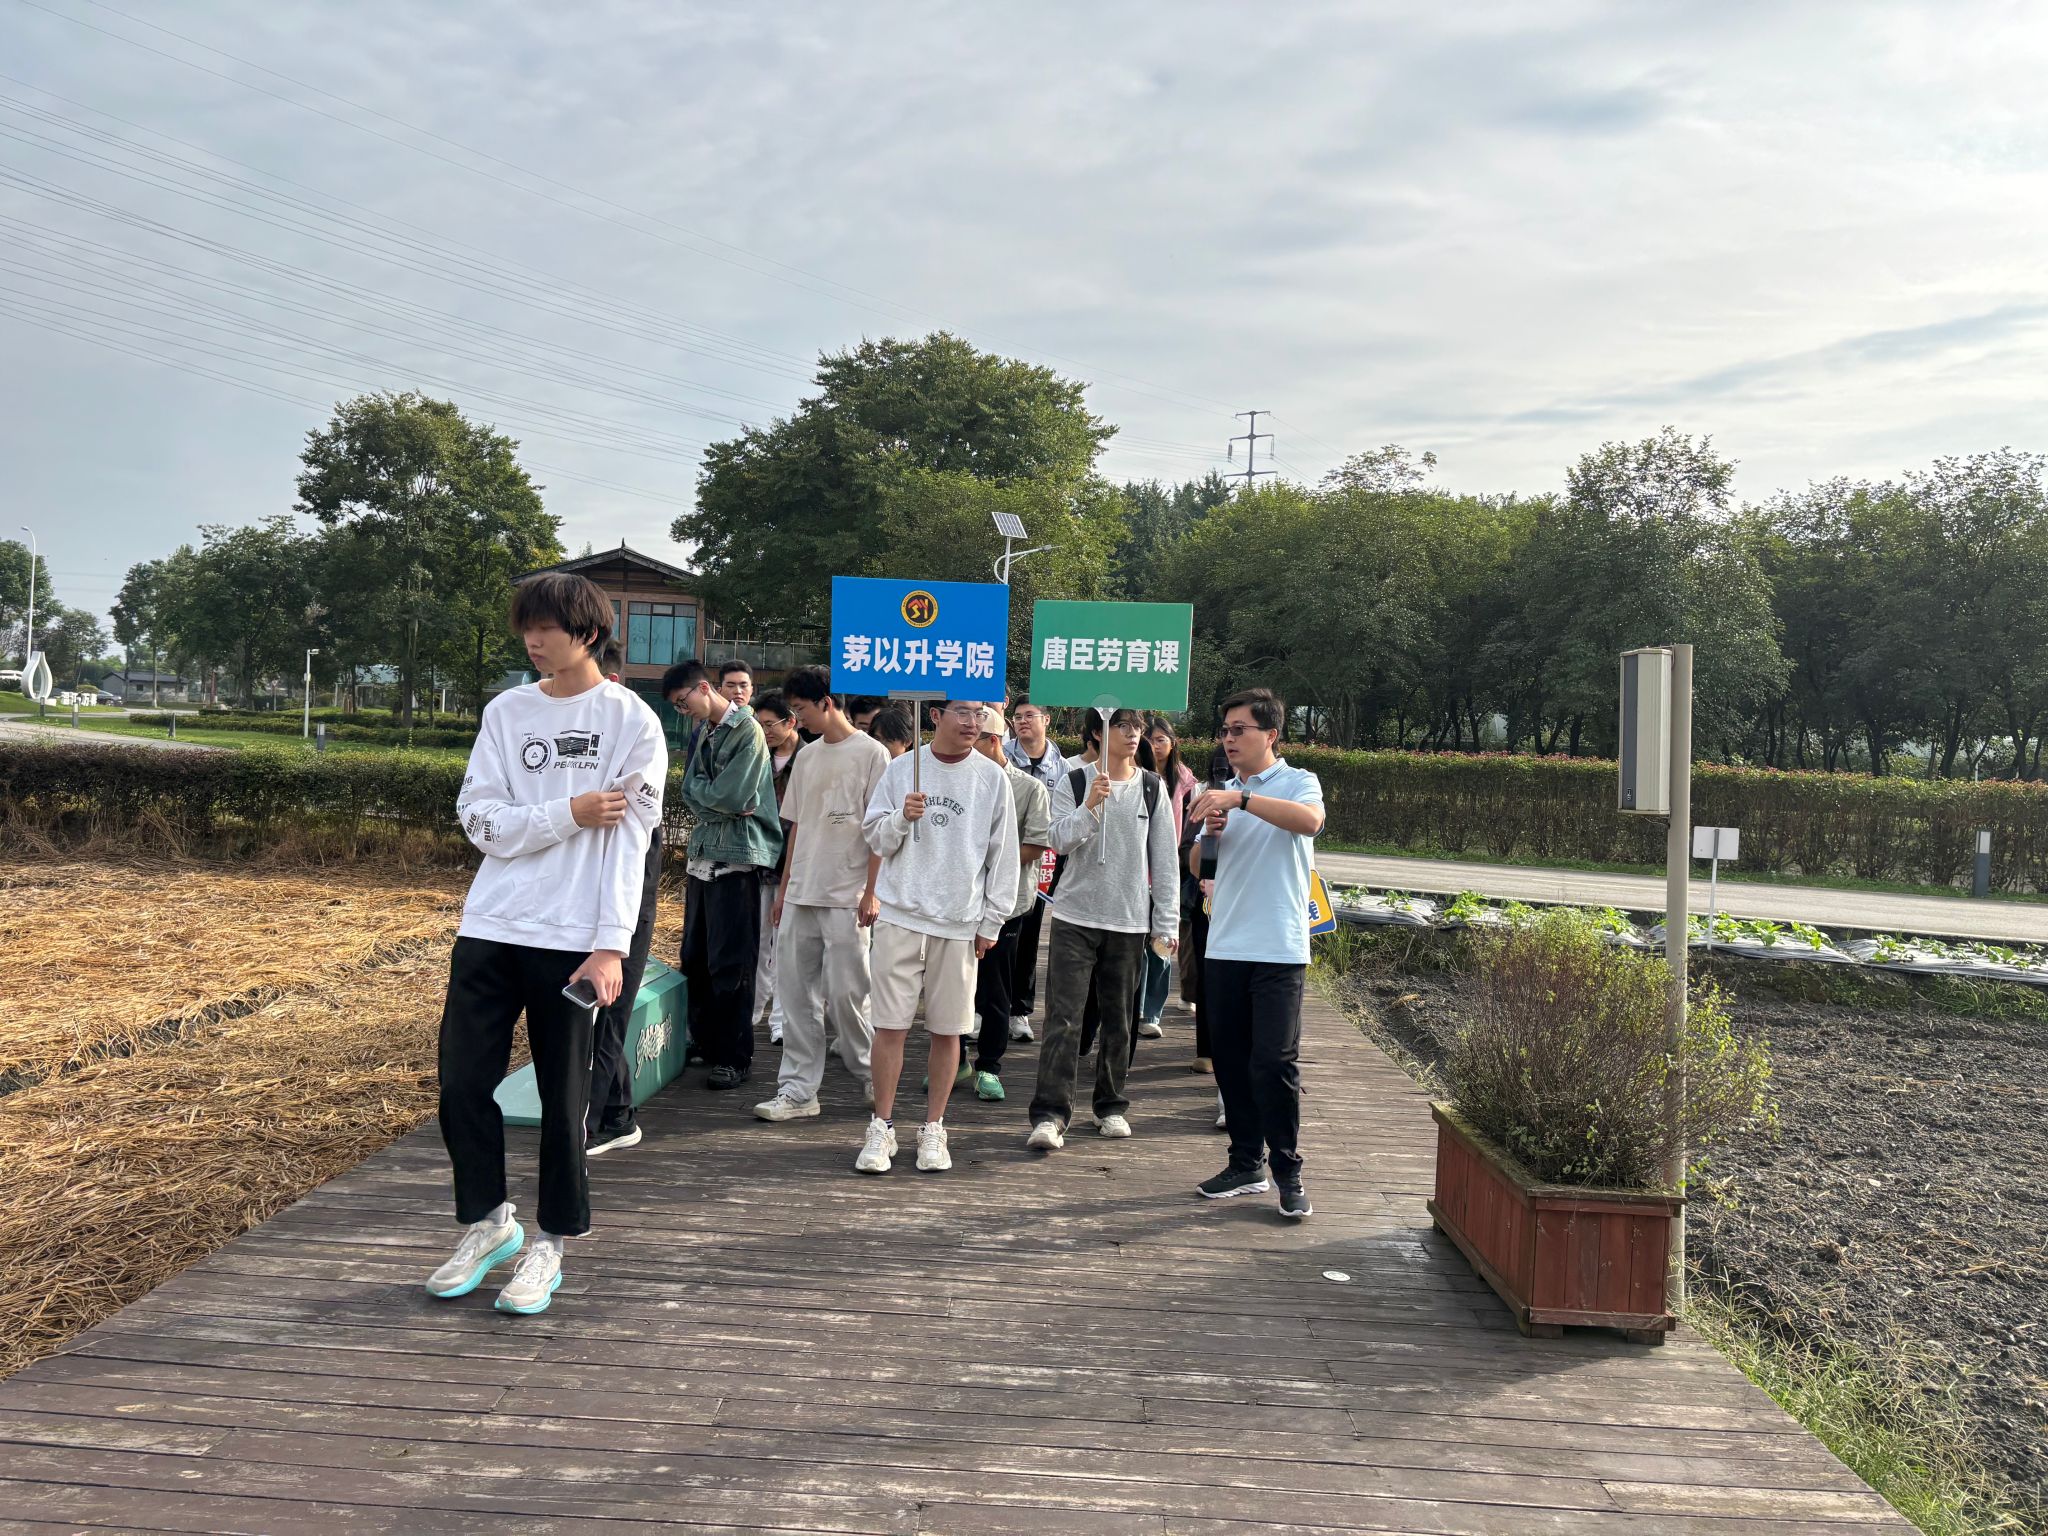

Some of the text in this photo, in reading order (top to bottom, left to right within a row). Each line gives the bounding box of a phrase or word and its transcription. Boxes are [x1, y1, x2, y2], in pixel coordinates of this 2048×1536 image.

[842, 634, 995, 679] 茅以升学院
[1041, 637, 1180, 674] 唐臣劳育课
[484, 820, 492, 842] BUG
